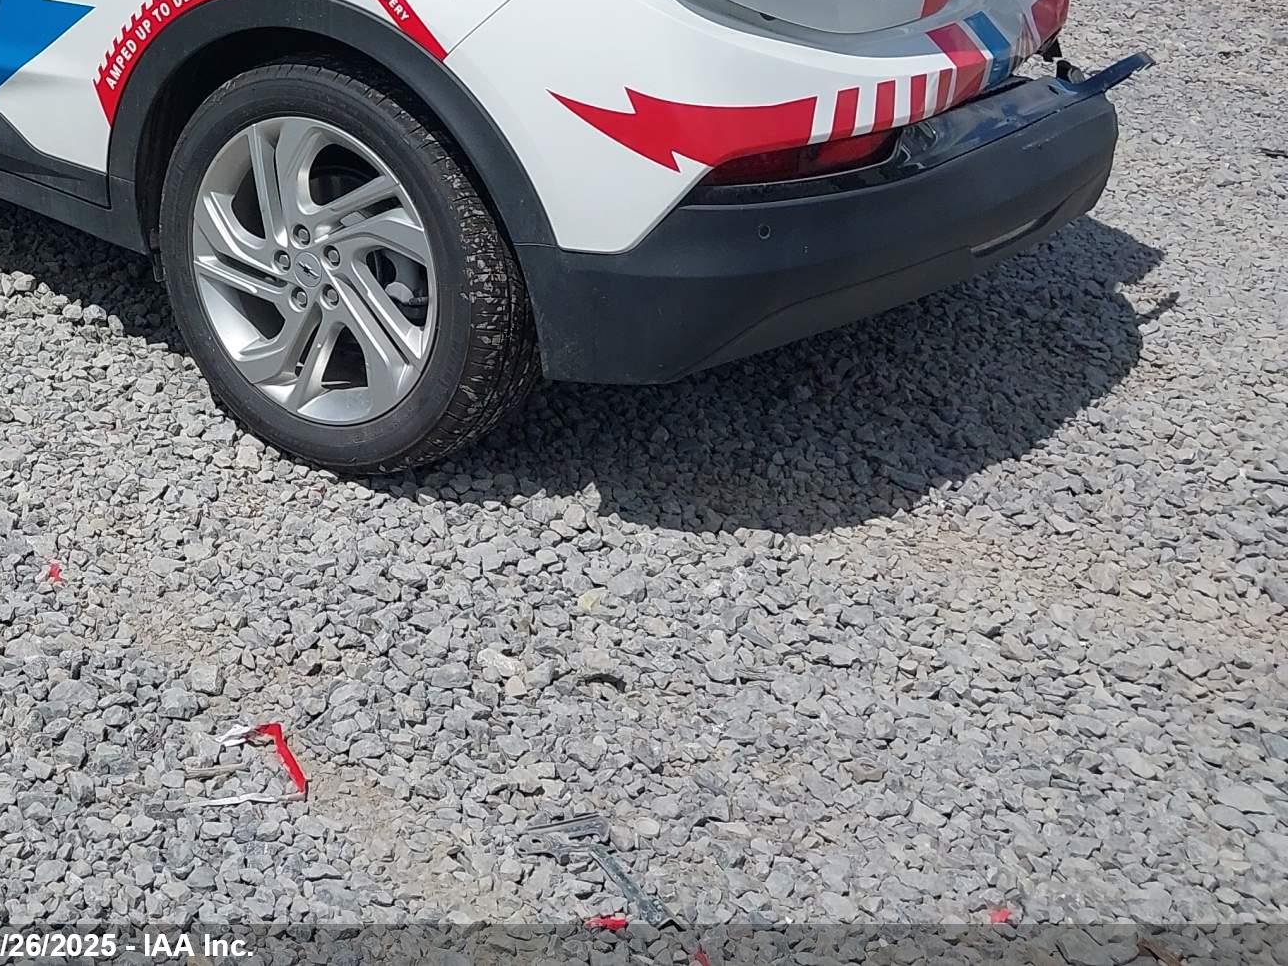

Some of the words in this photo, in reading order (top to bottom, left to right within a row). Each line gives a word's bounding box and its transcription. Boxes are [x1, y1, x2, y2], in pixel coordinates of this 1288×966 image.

[105, 39, 137, 91] AMPED
[134, 19, 152, 41] UP
[152, 3, 171, 23] TO
